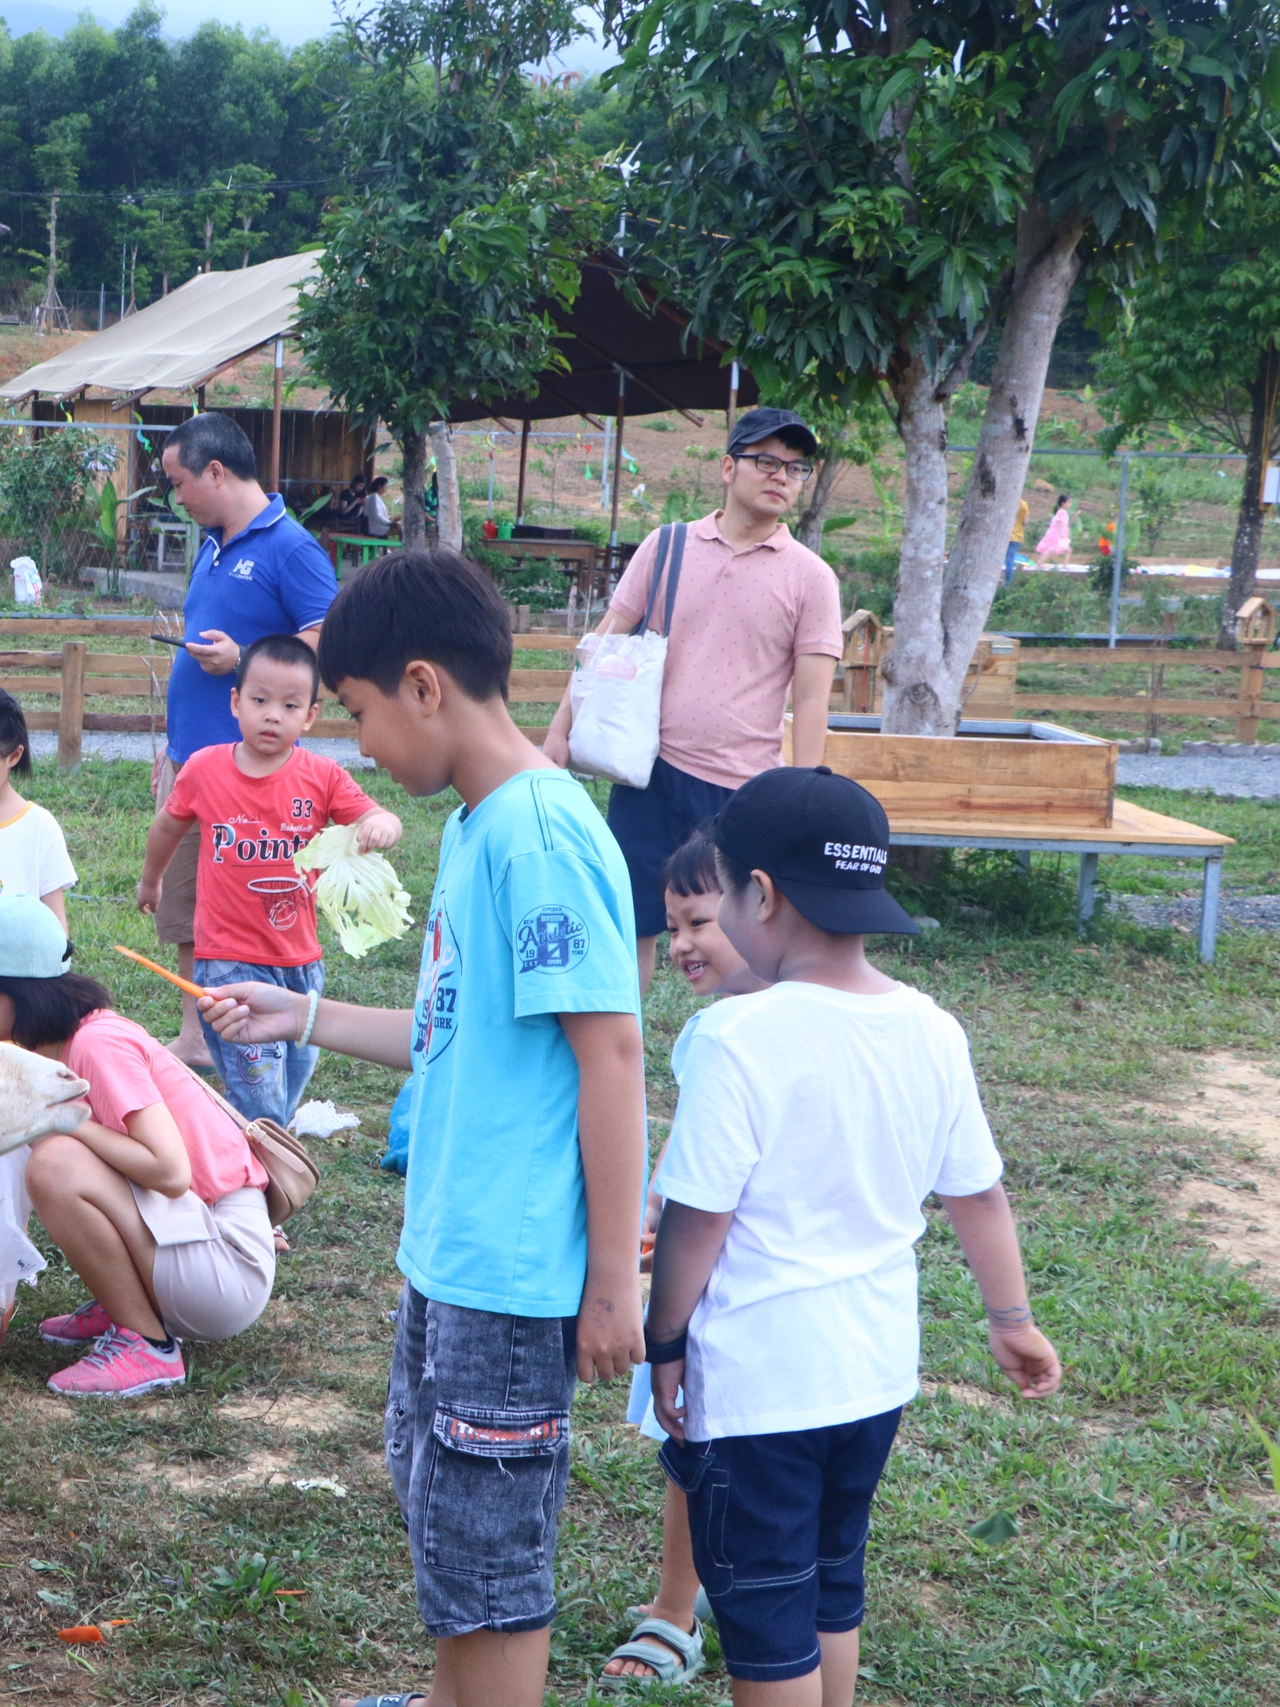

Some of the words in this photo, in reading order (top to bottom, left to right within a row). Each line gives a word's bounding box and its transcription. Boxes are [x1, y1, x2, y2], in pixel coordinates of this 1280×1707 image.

[292, 798, 314, 818] 33
[211, 823, 310, 863] Point
[824, 842, 888, 865] ESSENTIALS
[835, 860, 860, 871] FEAR
[860, 862, 870, 872] OF
[869, 864, 882, 874] GOD
[518, 921, 584, 953] Athletic
[525, 949, 535, 958] 19
[573, 939, 585, 949] 87
[435, 987, 457, 1013] 87
[434, 1017, 452, 1030] ORK
